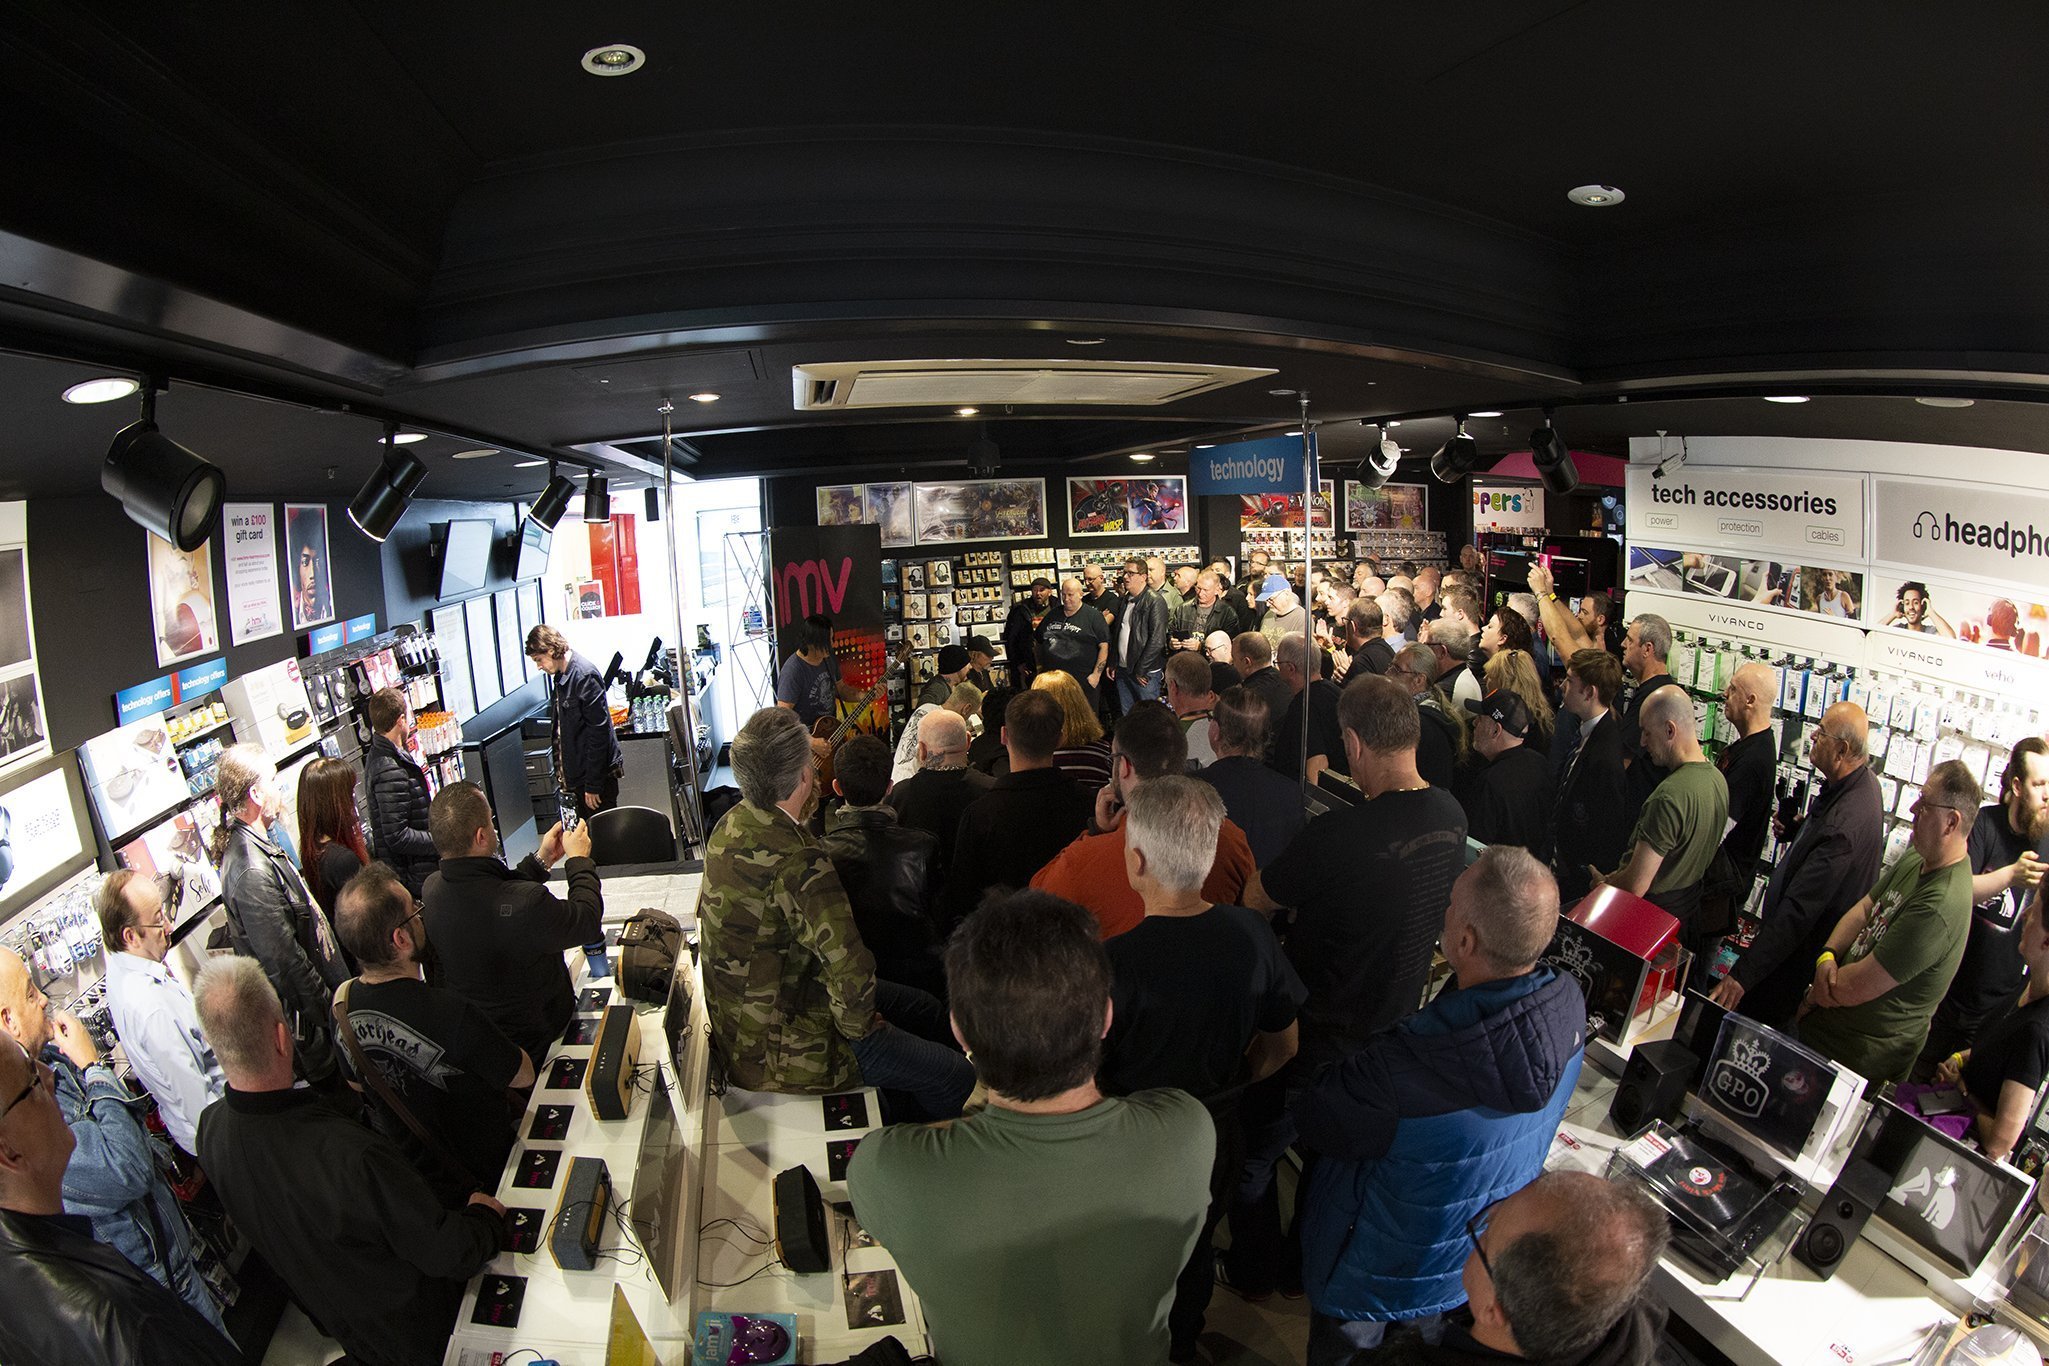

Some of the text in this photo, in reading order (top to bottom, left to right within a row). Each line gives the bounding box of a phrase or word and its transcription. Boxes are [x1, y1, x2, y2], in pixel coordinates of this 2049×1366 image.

[1210, 454, 1284, 482] technology
[1297, 493, 1327, 508] VNOM
[1651, 484, 1837, 516] tech accessories
[231, 514, 267, 526] win a £100
[1103, 518, 1124, 532] WASP
[1650, 515, 1673, 526] power
[1720, 521, 1760, 535] protection
[235, 528, 264, 543] gift card
[1811, 529, 1839, 542] cables
[1708, 614, 1764, 631] VIVANCO
[1887, 646, 1944, 667] VIVANCO
[181, 669, 225, 691] technology offers
[121, 688, 171, 713] technology offers
[1717, 1070, 1760, 1107] GPO
